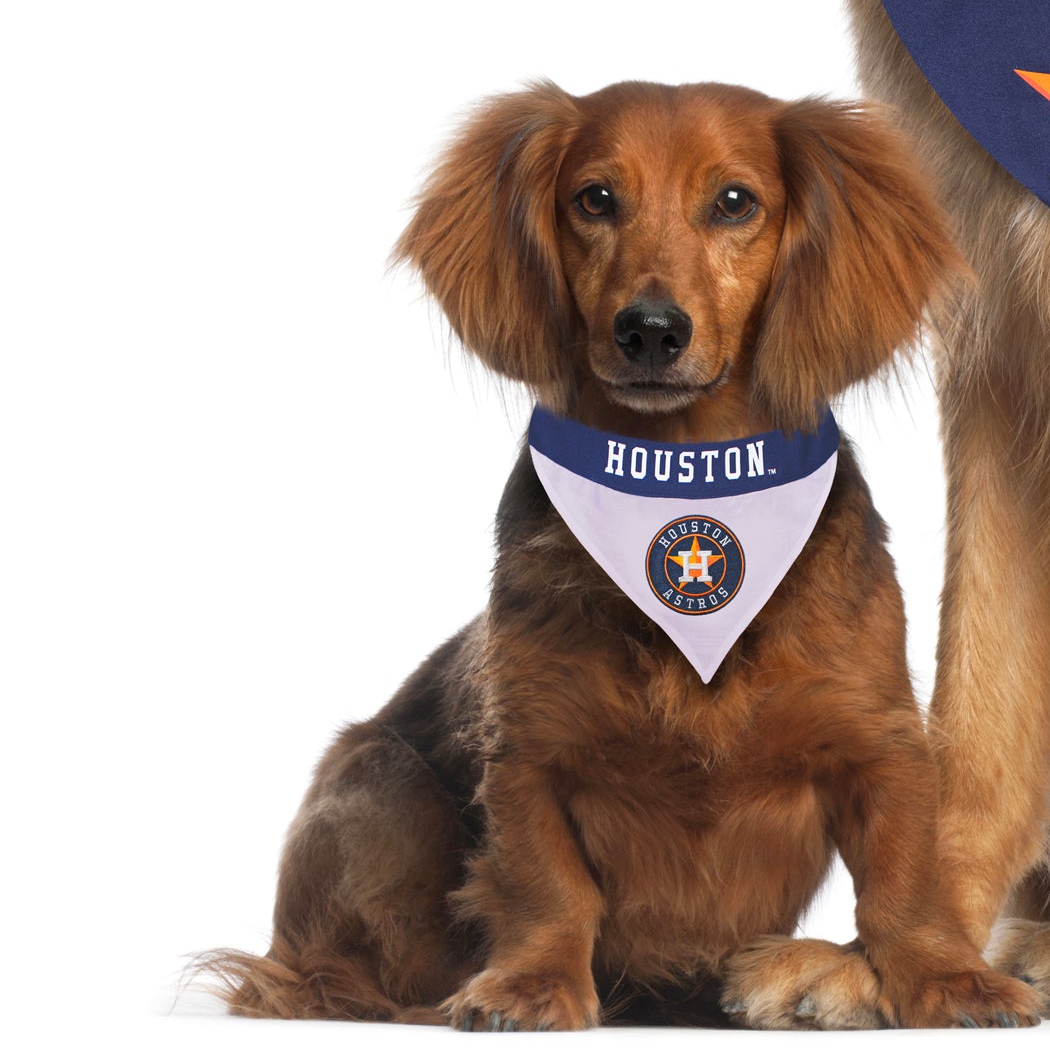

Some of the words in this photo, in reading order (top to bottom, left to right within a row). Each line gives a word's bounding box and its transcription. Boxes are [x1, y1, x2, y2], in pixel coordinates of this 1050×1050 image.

[605, 440, 765, 483] HOUSTON
[658, 521, 732, 548] HOUSTON
[678, 550, 713, 582] H
[663, 587, 728, 609] ASTROS
